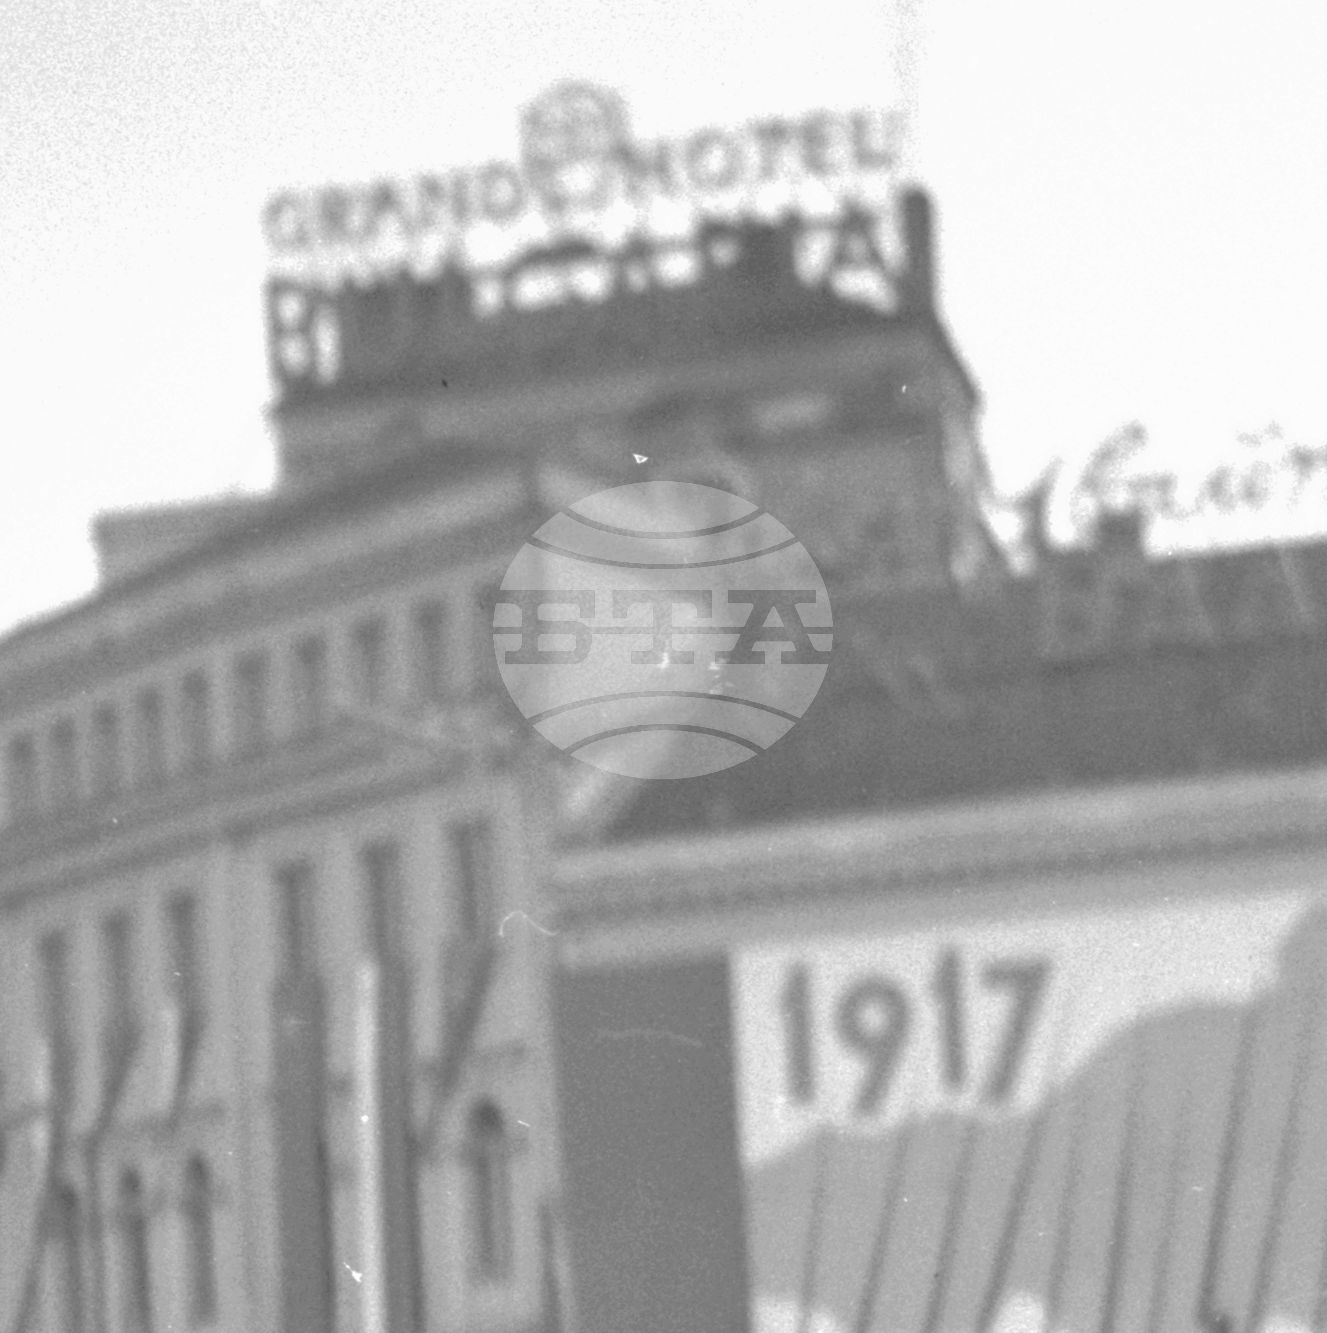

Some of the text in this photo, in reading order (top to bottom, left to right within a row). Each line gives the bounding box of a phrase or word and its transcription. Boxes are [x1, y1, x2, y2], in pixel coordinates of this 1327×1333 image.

[265, 108, 908, 252] GRAND HOTEL
[268, 205, 907, 388] BUGARA
[782, 945, 1052, 1118] 1917
